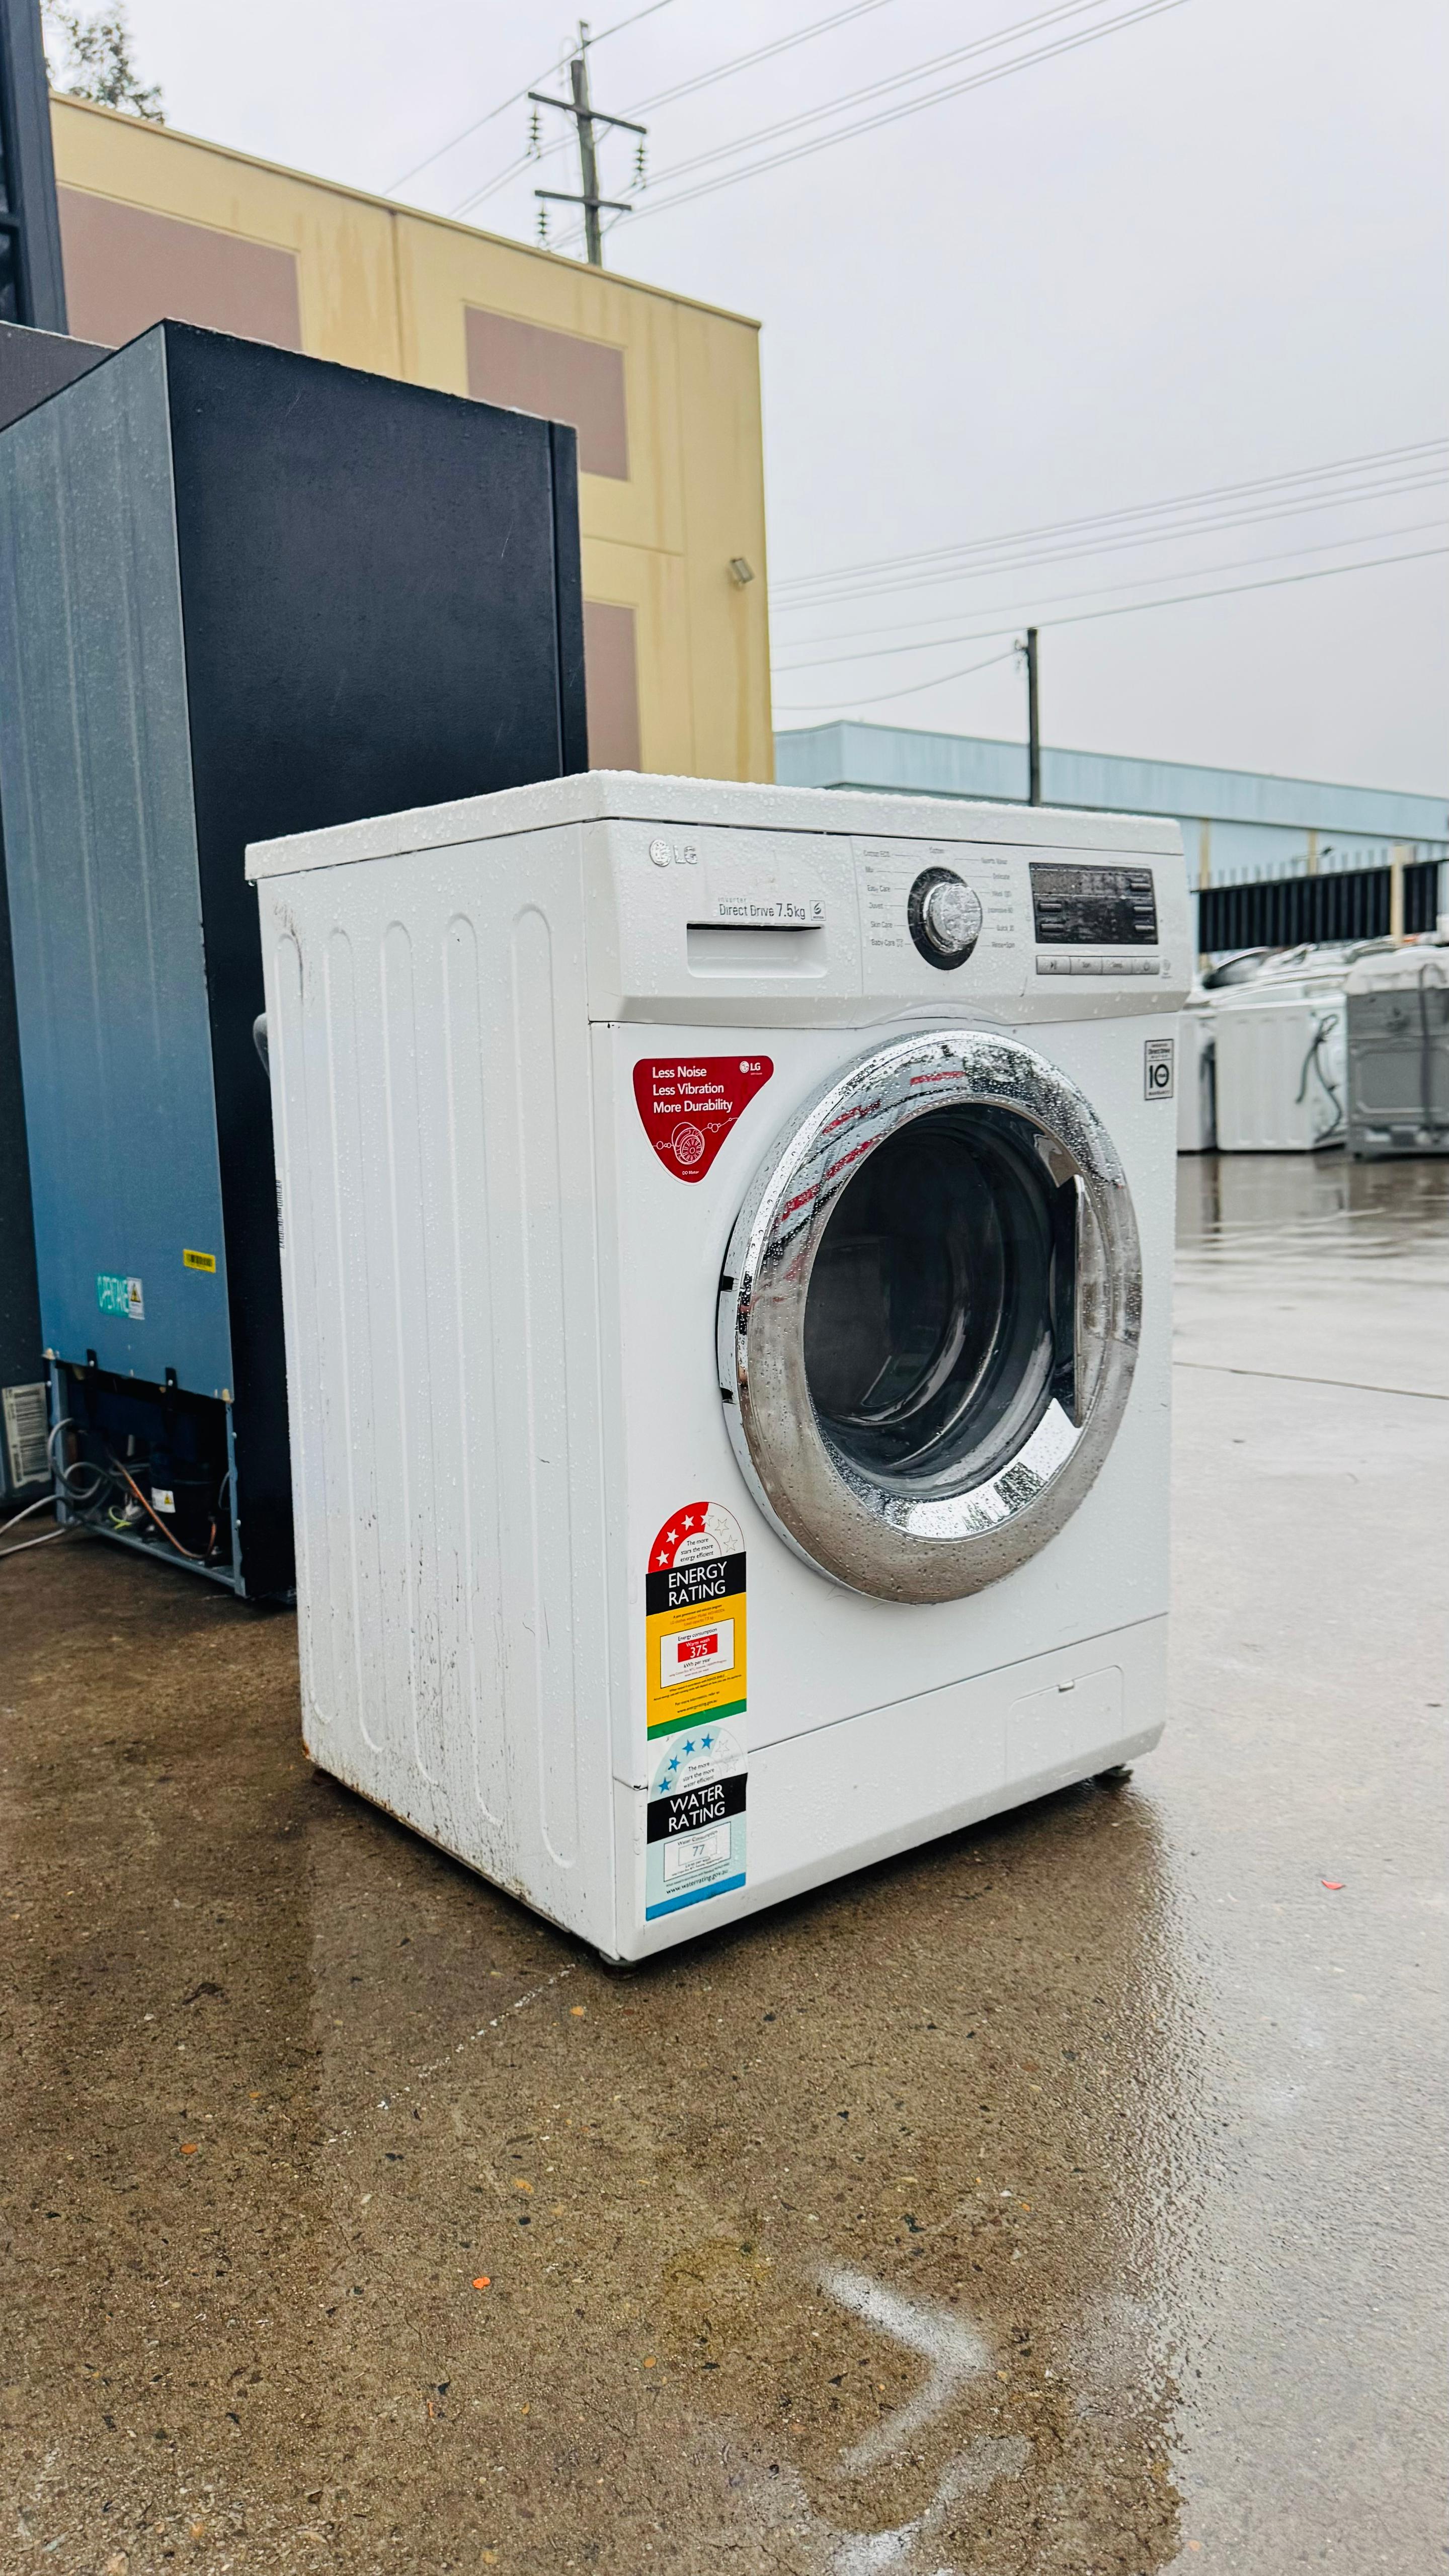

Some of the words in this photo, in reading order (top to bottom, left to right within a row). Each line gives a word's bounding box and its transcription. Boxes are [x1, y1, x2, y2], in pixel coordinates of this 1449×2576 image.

[673, 845, 698, 864] LG
[719, 904, 748, 916] Direct
[750, 905, 774, 917] Drive
[652, 1066, 675, 1078] Less
[677, 1065, 707, 1078] Noise
[750, 1062, 761, 1071] LG
[1149, 1064, 1169, 1089] 10
[653, 1084, 676, 1096] Less
[677, 1082, 725, 1095] Vibration
[654, 1101, 682, 1113] More
[684, 1098, 733, 1113] Durability
[668, 1561, 728, 1588] ENERGY
[669, 1580, 726, 1606] RATING
[692, 1628, 717, 1638] consumption
[690, 1643, 708, 1658] 375
[670, 1784, 725, 1813] WATER
[668, 1801, 725, 1832] RATING
[693, 1844, 705, 1857] 77
